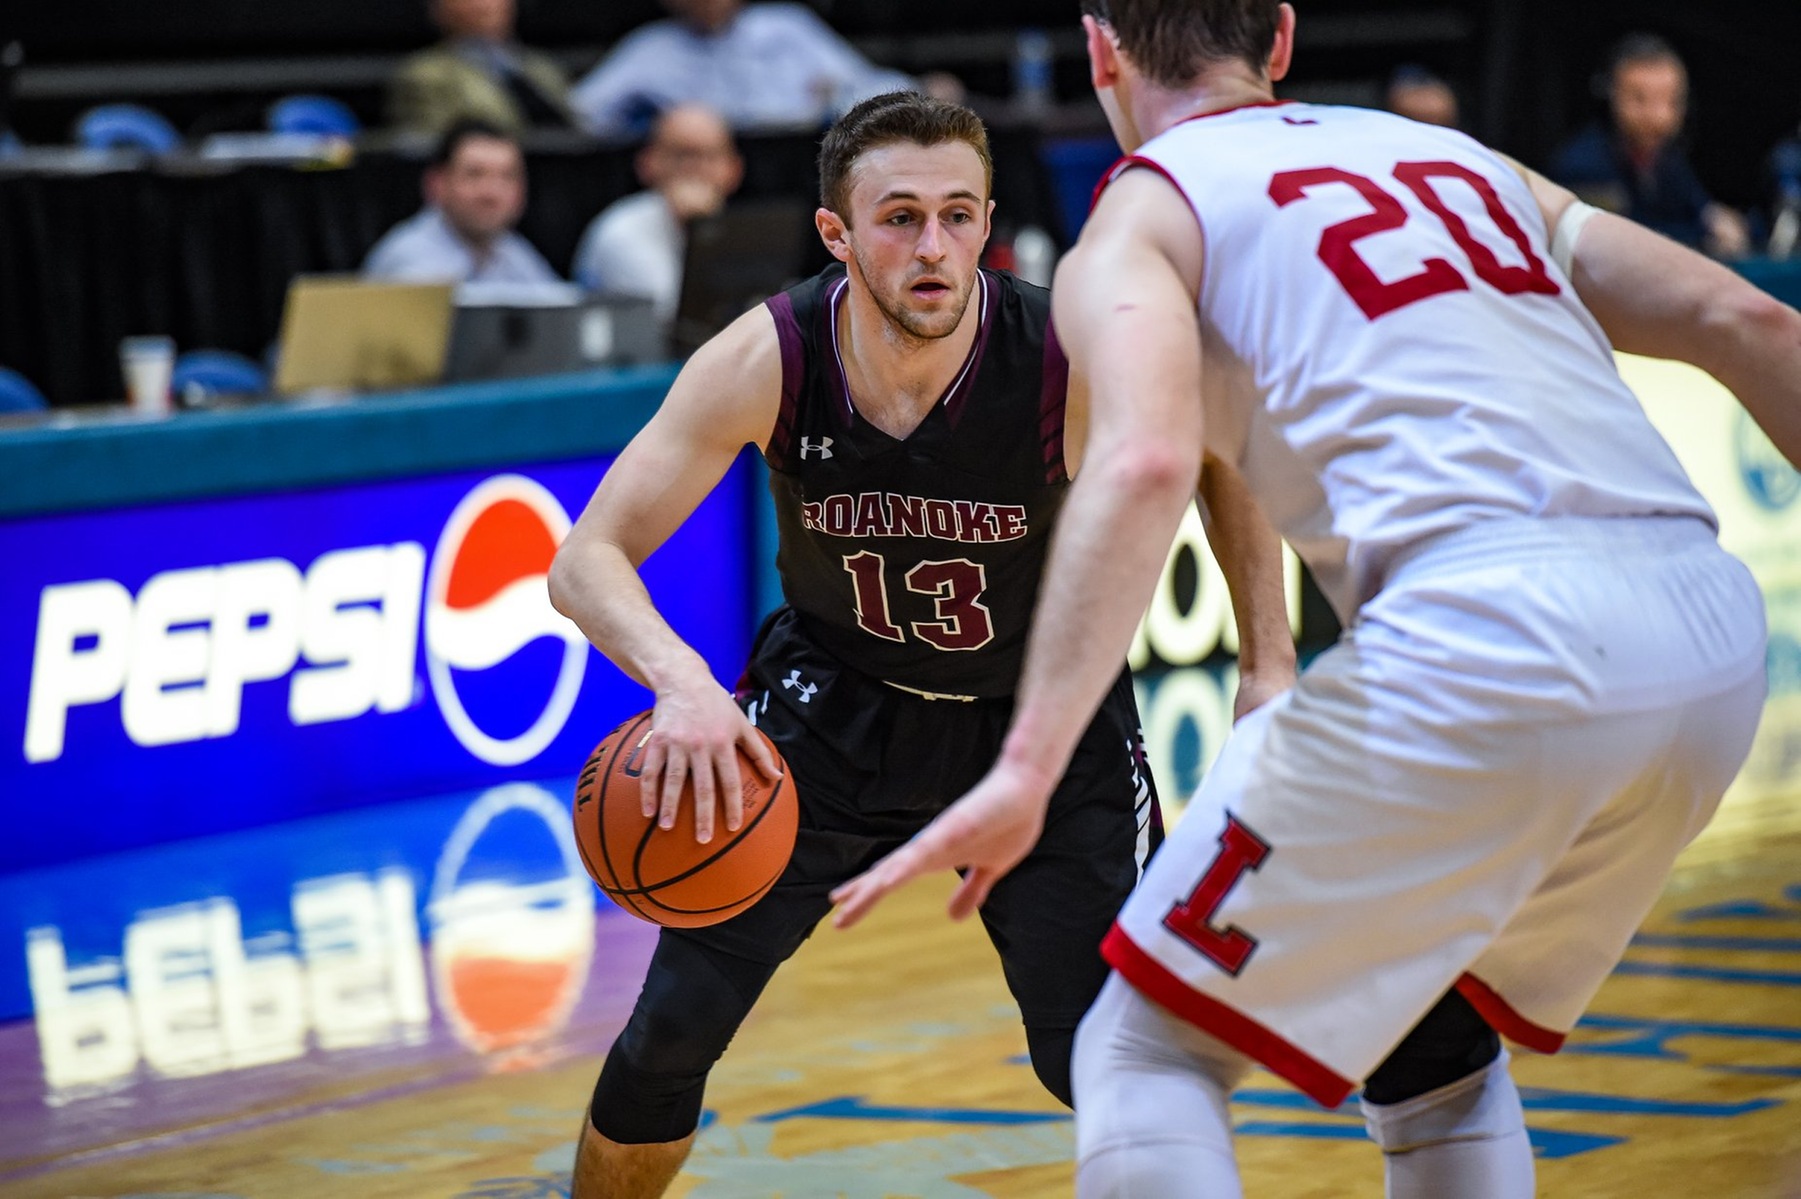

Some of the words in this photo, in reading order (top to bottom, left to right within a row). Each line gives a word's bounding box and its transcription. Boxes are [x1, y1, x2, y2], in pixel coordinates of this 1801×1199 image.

[1267, 161, 1561, 322] 20
[801, 491, 1028, 543] ROANOKE
[23, 540, 427, 764] PEPSI
[841, 549, 995, 651] 13
[1162, 808, 1273, 978] L
